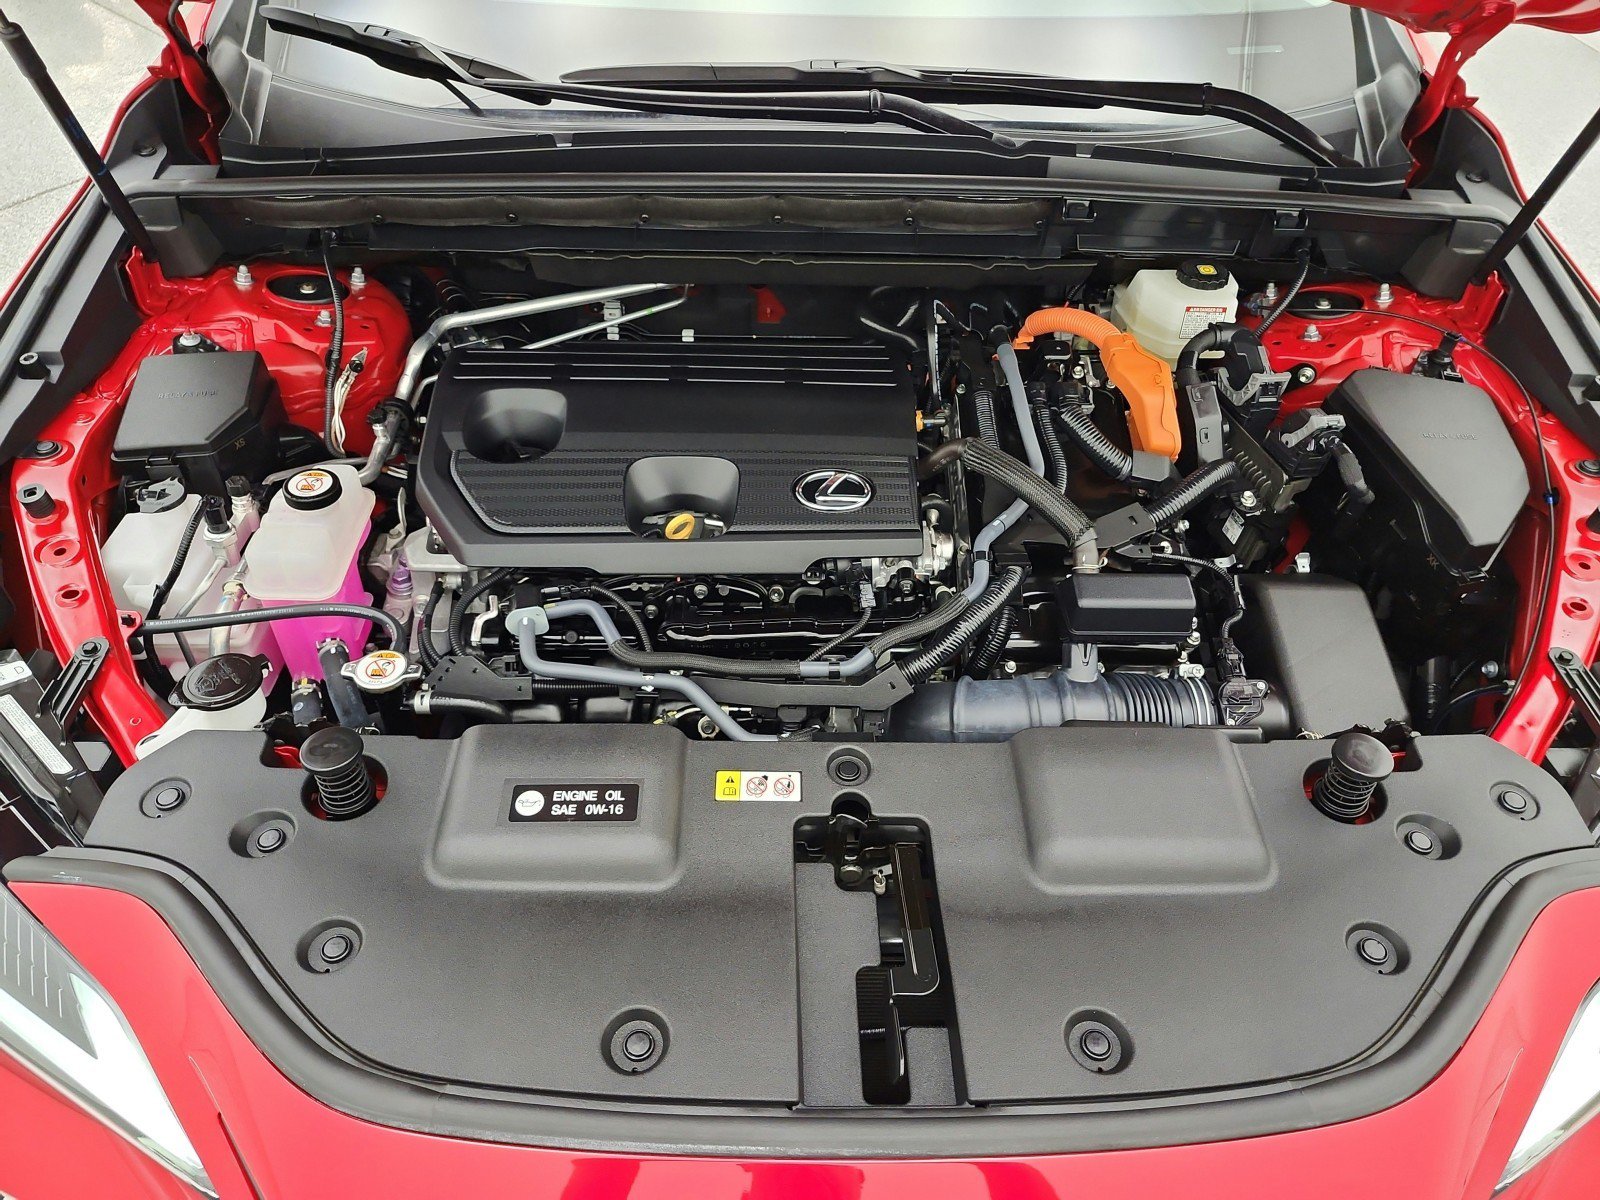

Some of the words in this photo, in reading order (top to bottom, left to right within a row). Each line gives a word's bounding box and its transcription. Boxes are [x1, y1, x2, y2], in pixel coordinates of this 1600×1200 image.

[552, 790, 598, 801] ENGINE
[604, 790, 625, 801] OIL
[551, 804, 577, 815] SAE
[584, 804, 624, 815] 0W-16
